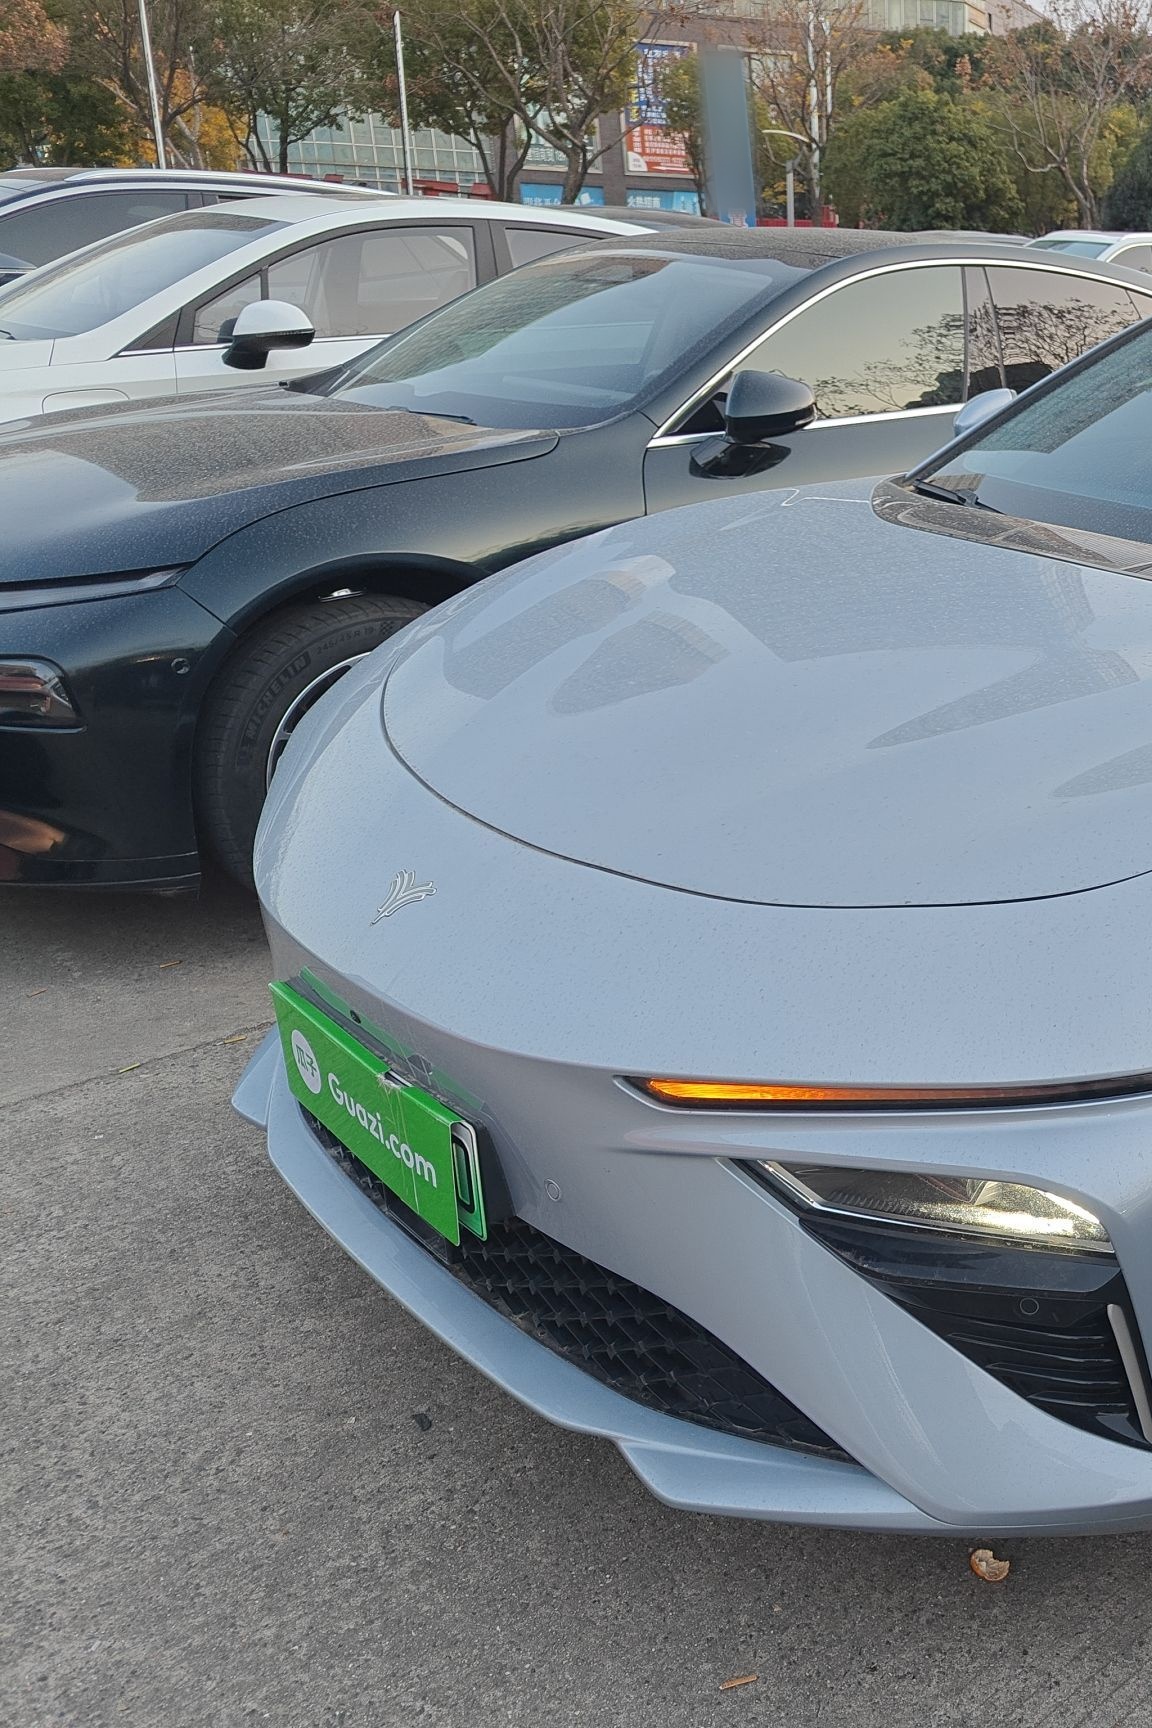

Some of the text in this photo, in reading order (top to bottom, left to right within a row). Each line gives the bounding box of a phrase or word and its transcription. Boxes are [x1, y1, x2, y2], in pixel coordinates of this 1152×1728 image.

[246, 652, 310, 738] MICHELIN
[295, 1043, 318, 1078] 瓜子
[327, 1072, 438, 1188] Guazi.com
